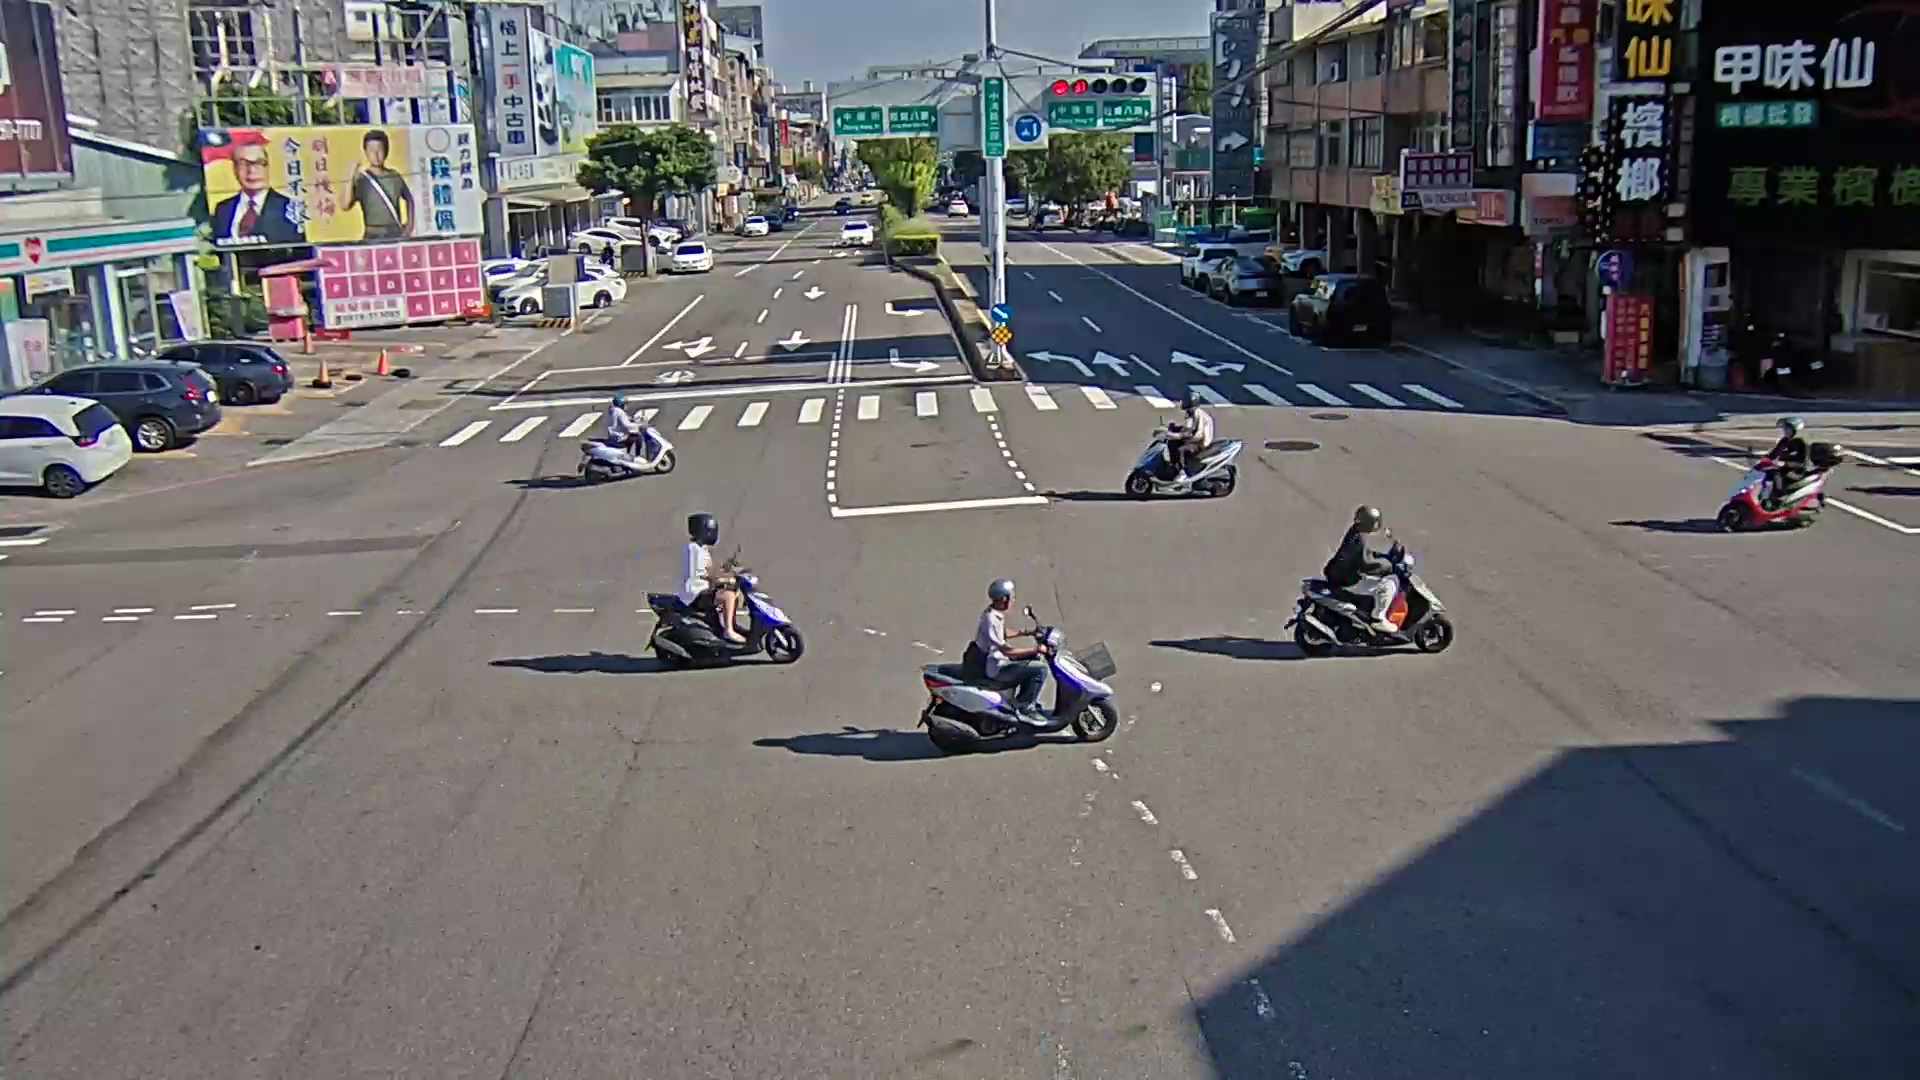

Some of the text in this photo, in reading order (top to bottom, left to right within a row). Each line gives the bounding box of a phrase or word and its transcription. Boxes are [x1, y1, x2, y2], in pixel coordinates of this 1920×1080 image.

[1713, 36, 1877, 95] 甲味仙
[1615, 101, 1665, 202] 檳榔
